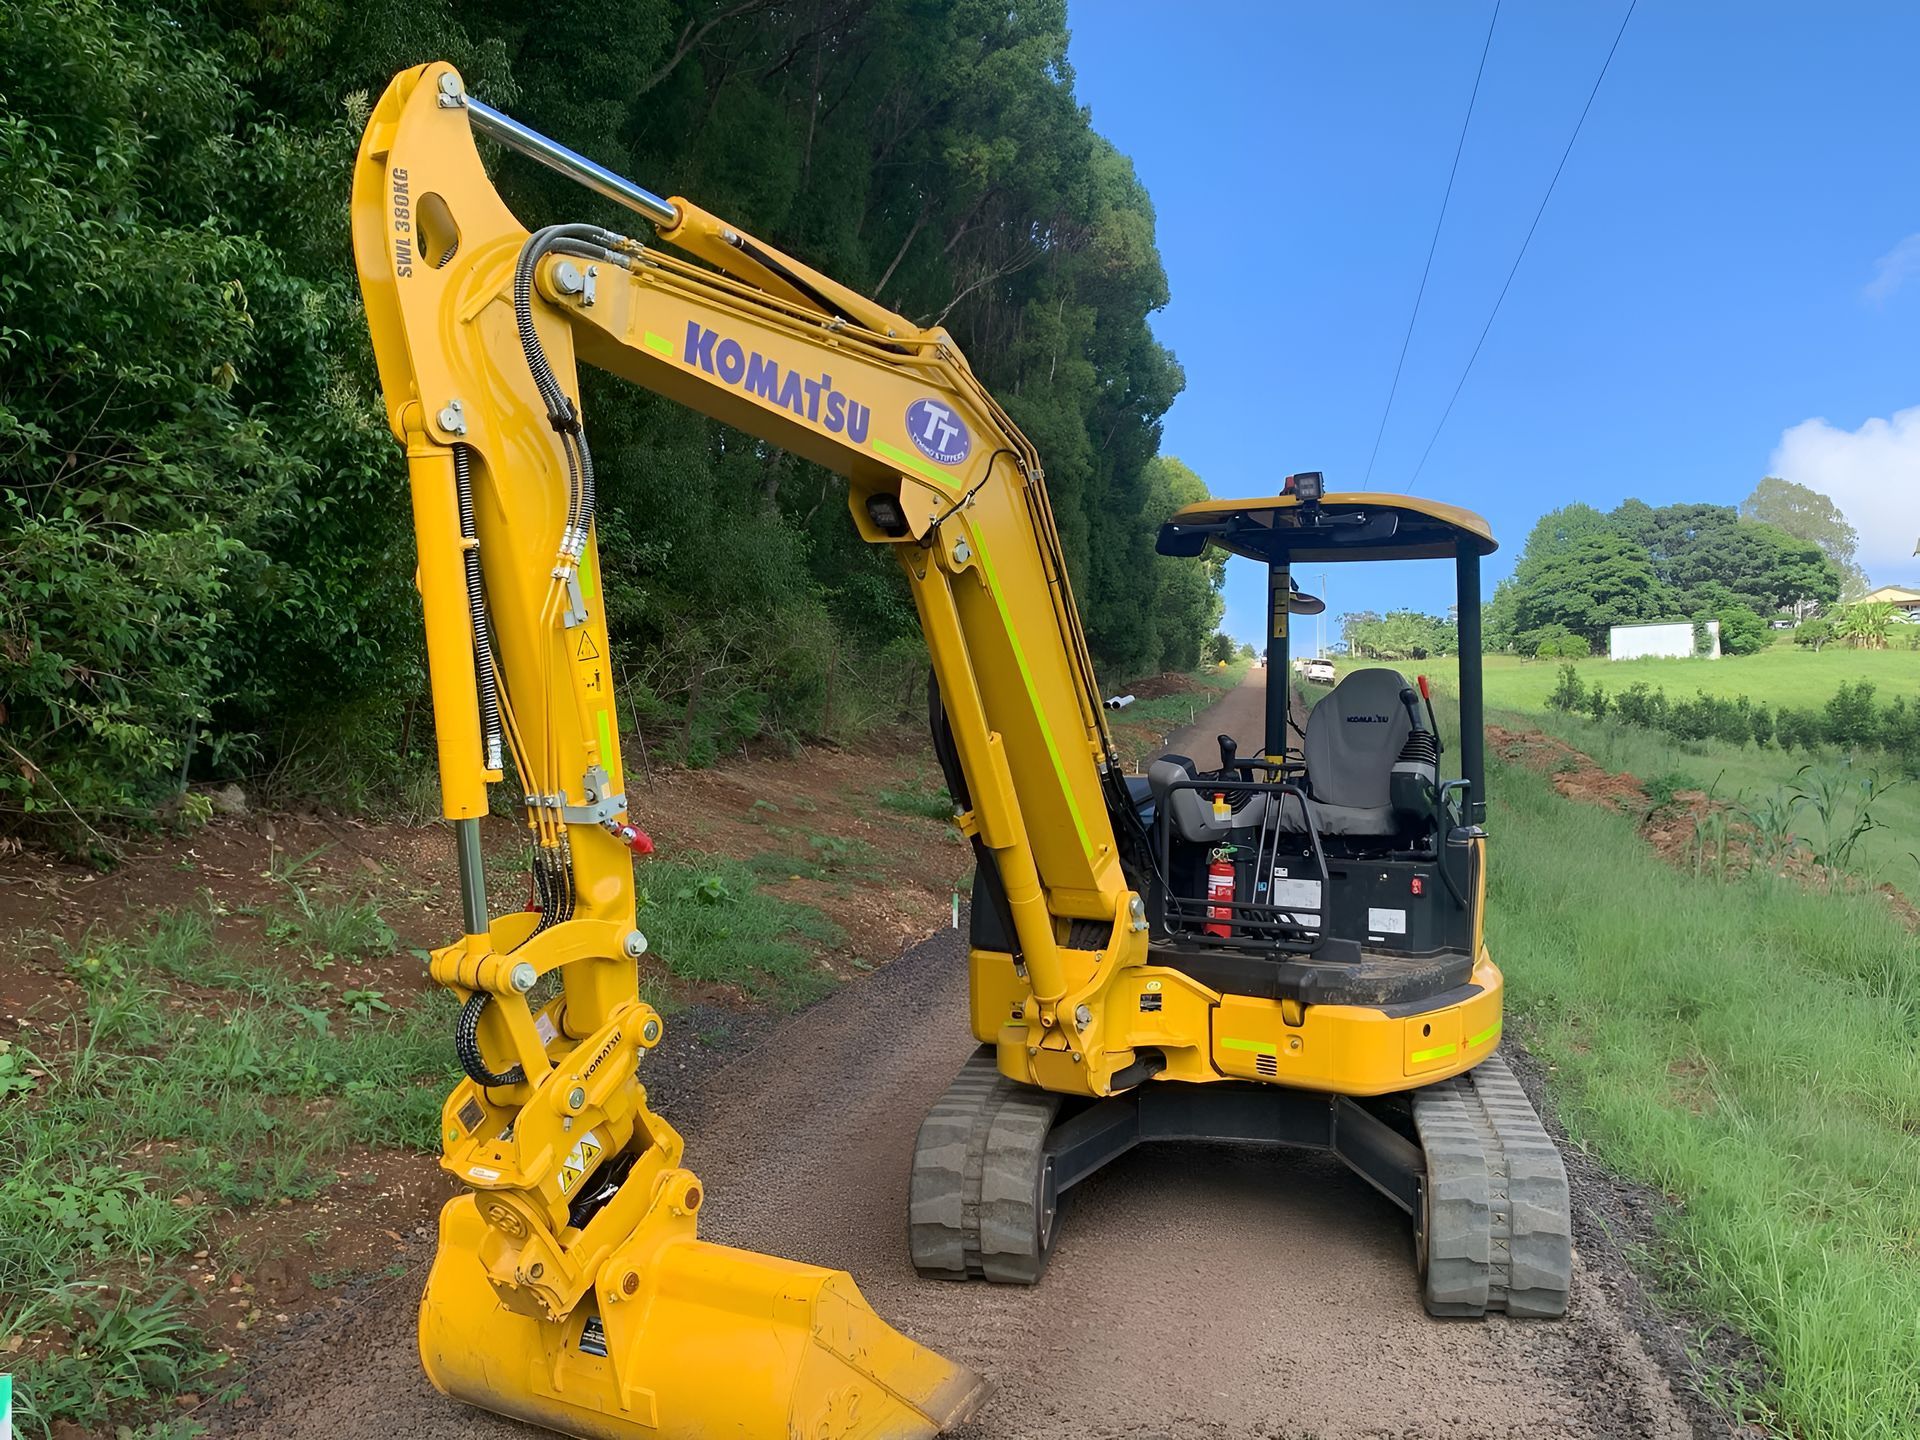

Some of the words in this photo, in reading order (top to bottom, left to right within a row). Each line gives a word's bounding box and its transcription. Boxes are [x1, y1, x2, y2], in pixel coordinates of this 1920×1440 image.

[393, 168, 411, 232] 380KG
[396, 238, 412, 278] SWL
[683, 320, 871, 444] KOMATSU
[583, 1031, 622, 1081] KOMATSU
